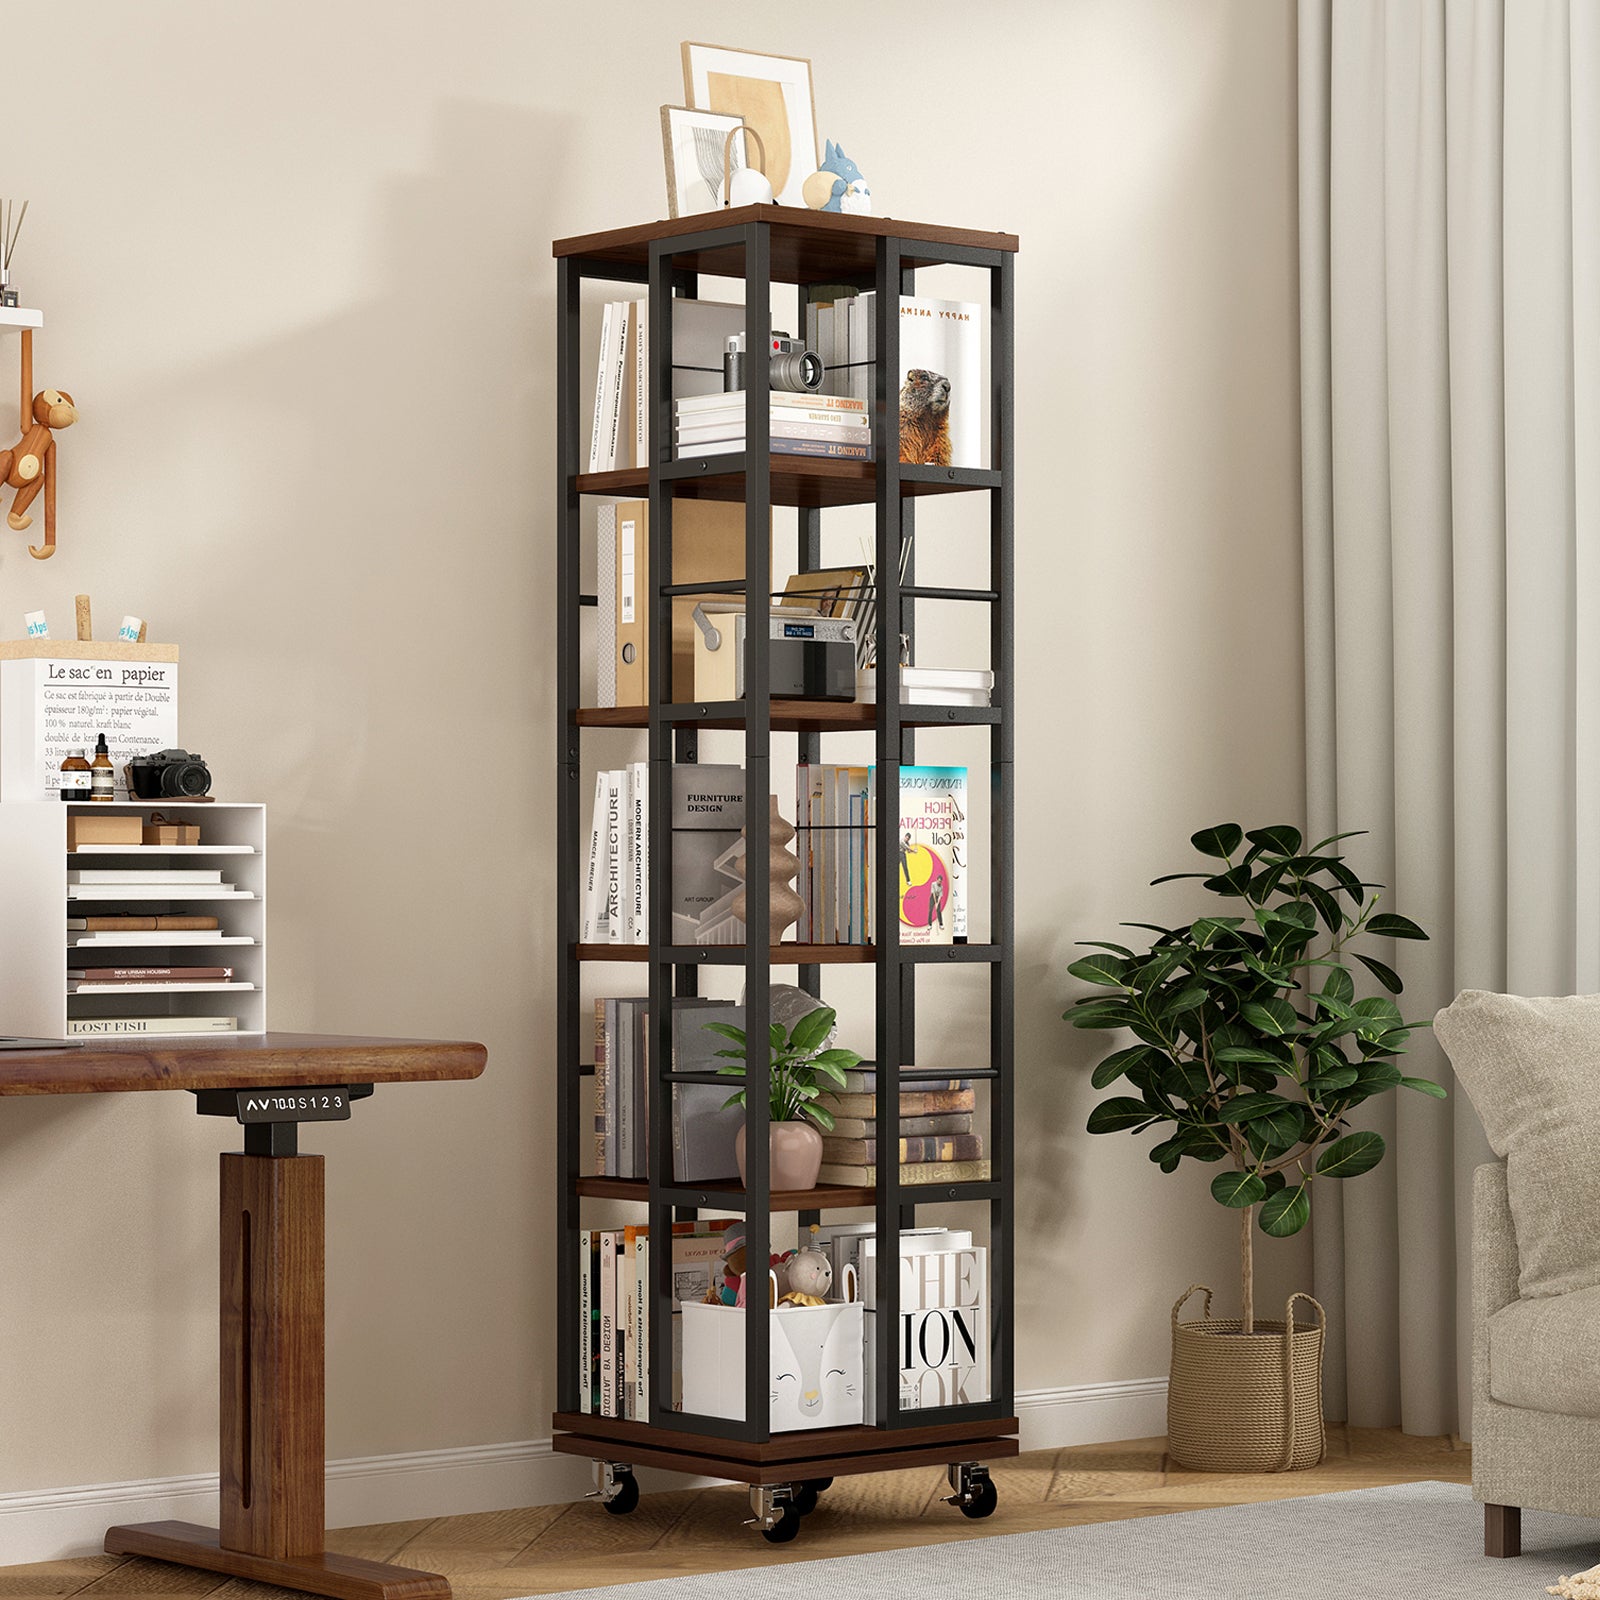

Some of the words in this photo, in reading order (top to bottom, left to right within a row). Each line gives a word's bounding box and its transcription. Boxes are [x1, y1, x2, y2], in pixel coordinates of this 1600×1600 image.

[826, 398, 835, 407] IT
[836, 399, 864, 410] MAKING
[828, 445, 837, 454] IT
[838, 446, 866, 457] MAKING
[49, 664, 65, 679] Le
[69, 668, 90, 679] sac
[96, 668, 112, 679] en
[122, 666, 165, 684] papier
[44, 691, 54, 700] Ce
[78, 690, 106, 703] fabriqué
[108, 692, 113, 700] à
[114, 692, 134, 703] partir
[134, 692, 143, 701] de
[144, 693, 170, 702] Double
[44, 704, 75, 716] épaisseur
[111, 706, 132, 718] papier
[45, 719, 57, 727] 100
[58, 720, 66, 728] %
[96, 720, 112, 728] kraft
[113, 720, 131, 729] blanc
[44, 733, 69, 742] doublé
[71, 733, 81, 742] de
[84, 733, 100, 742] kraf
[687, 794, 743, 803] FURNITURE
[590, 830, 598, 860] MARCEL
[609, 787, 619, 918] ARCHITECTURE
[74, 1023, 111, 1032] LOST
[115, 1022, 146, 1031] FISH
[309, 1097, 316, 1108] 1
[321, 1096, 329, 1108] 2
[334, 1096, 342, 1108] 3
[901, 1307, 979, 1370] ION
